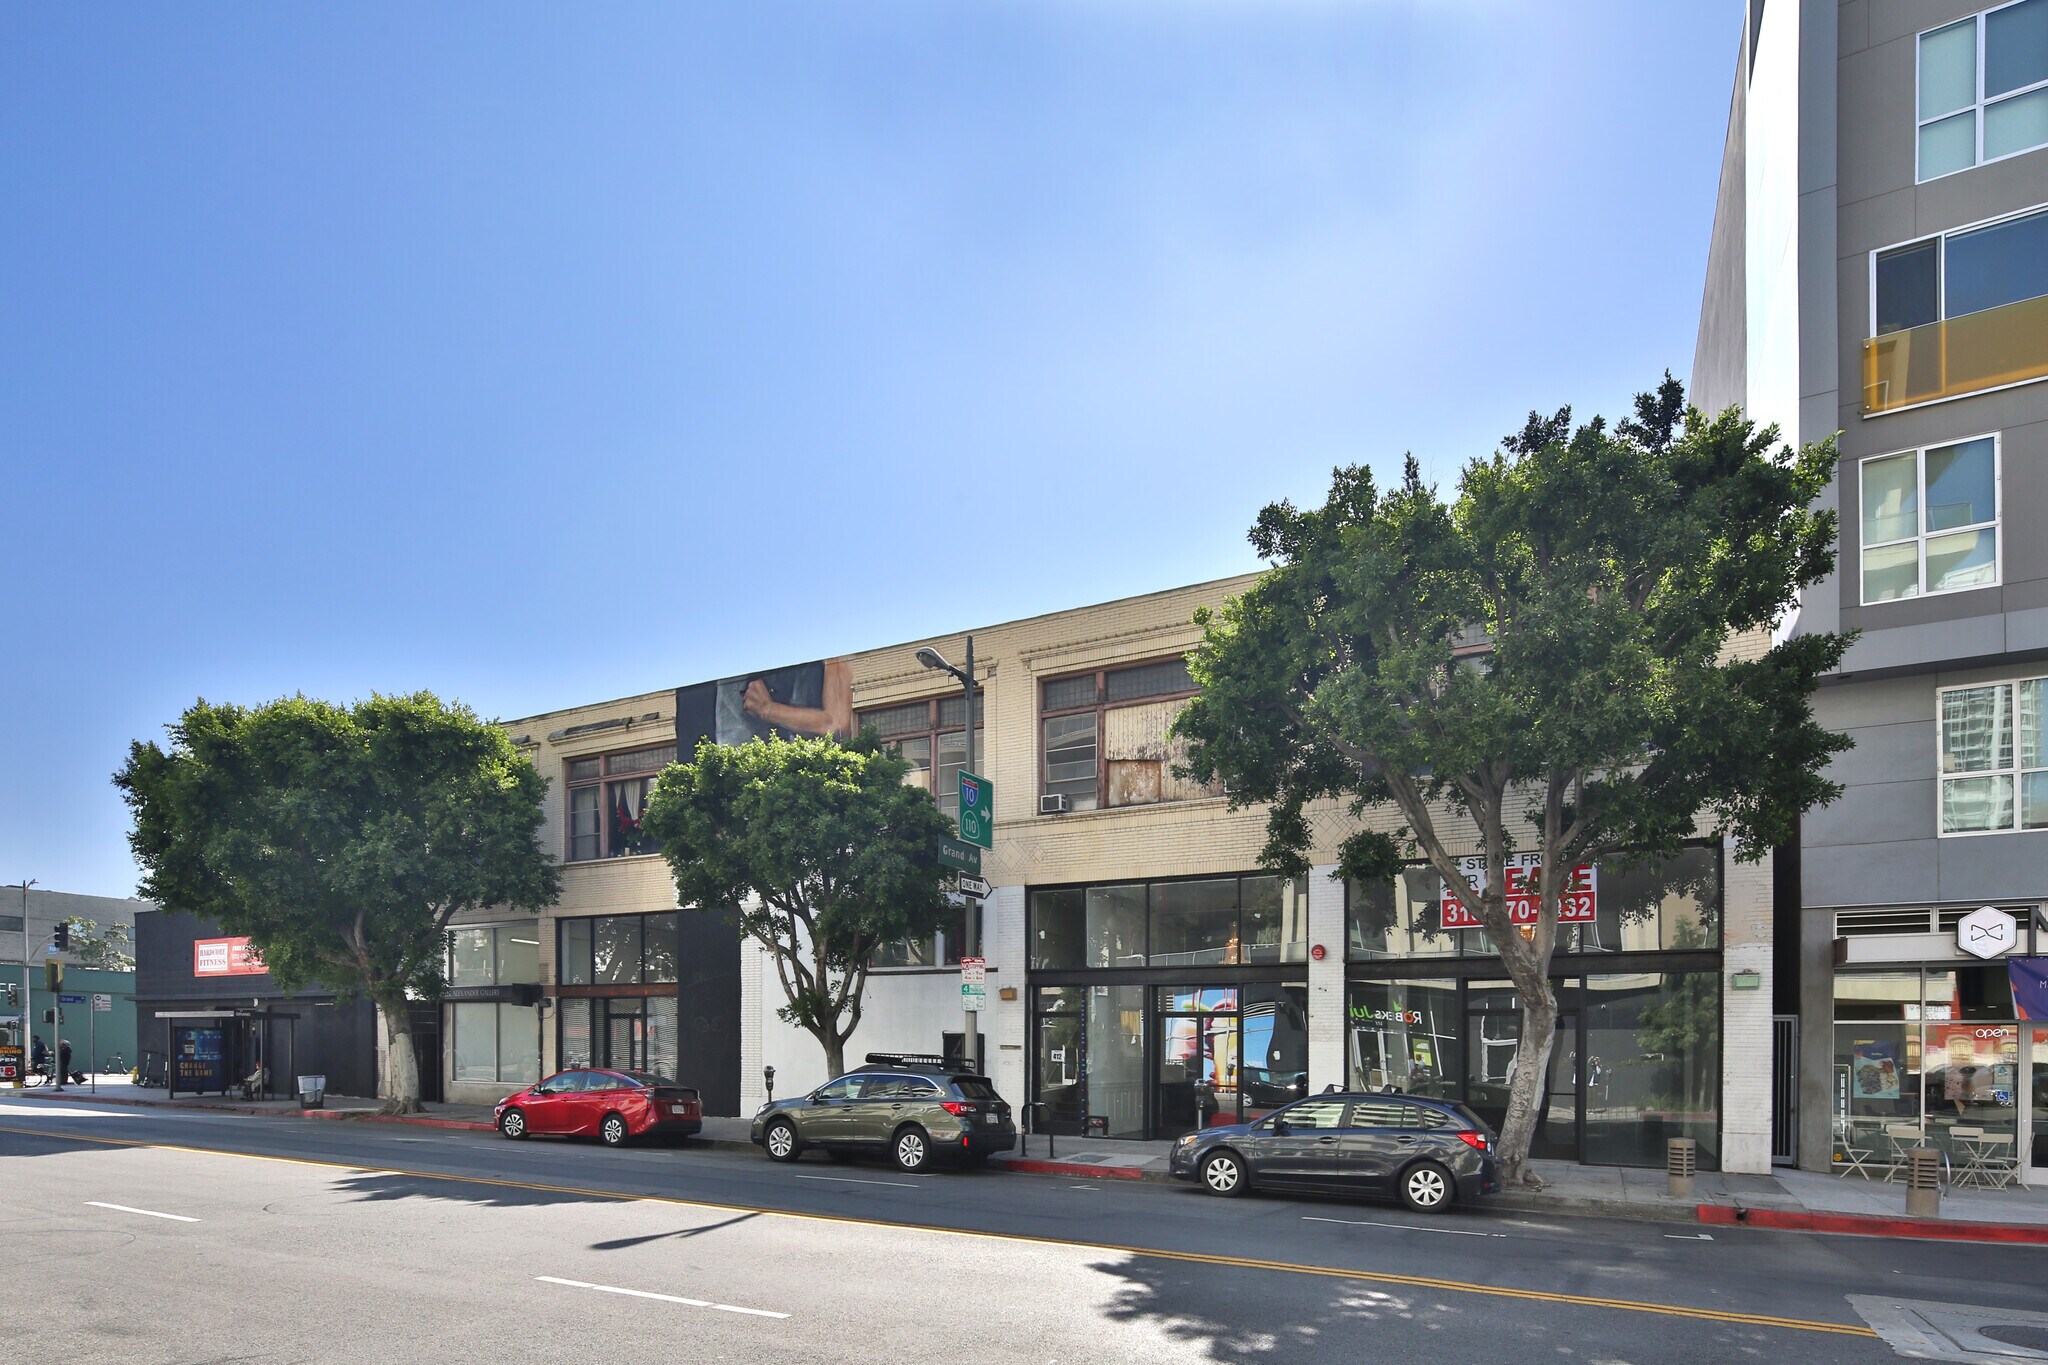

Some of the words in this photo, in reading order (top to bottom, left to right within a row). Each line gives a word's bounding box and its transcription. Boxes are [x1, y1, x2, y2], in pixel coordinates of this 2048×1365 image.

[966, 788, 975, 802] 10
[965, 818, 976, 833] 110
[942, 844, 965, 860] Grand
[968, 852, 978, 864] Av
[1466, 857, 1515, 869] STE
[962, 879, 972, 890] ONE
[973, 881, 983, 892] WAY
[1487, 864, 1592, 894] EAE
[200, 949, 226, 957] HARDCORE
[1975, 1028, 2009, 1040] open
